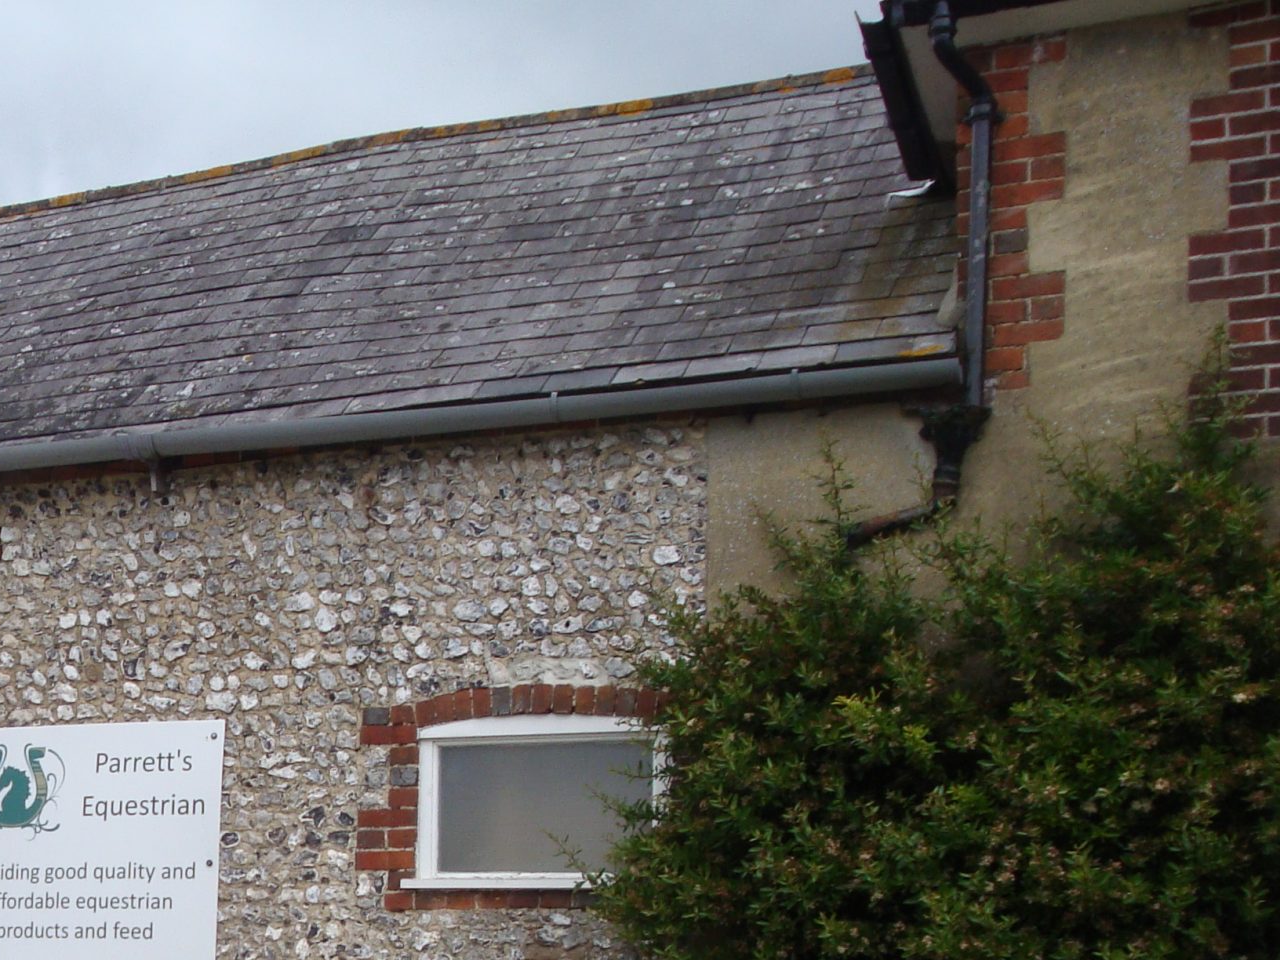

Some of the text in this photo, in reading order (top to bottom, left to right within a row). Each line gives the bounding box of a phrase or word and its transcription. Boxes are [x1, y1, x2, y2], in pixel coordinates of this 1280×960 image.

[95, 749, 193, 774] Parrett's
[82, 794, 206, 821] Equestrian
[44, 862, 87, 884] good
[93, 862, 155, 883] quality
[161, 862, 196, 880] and
[76, 892, 173, 913] equestrian
[74, 922, 108, 939] and
[113, 922, 154, 940] feed
